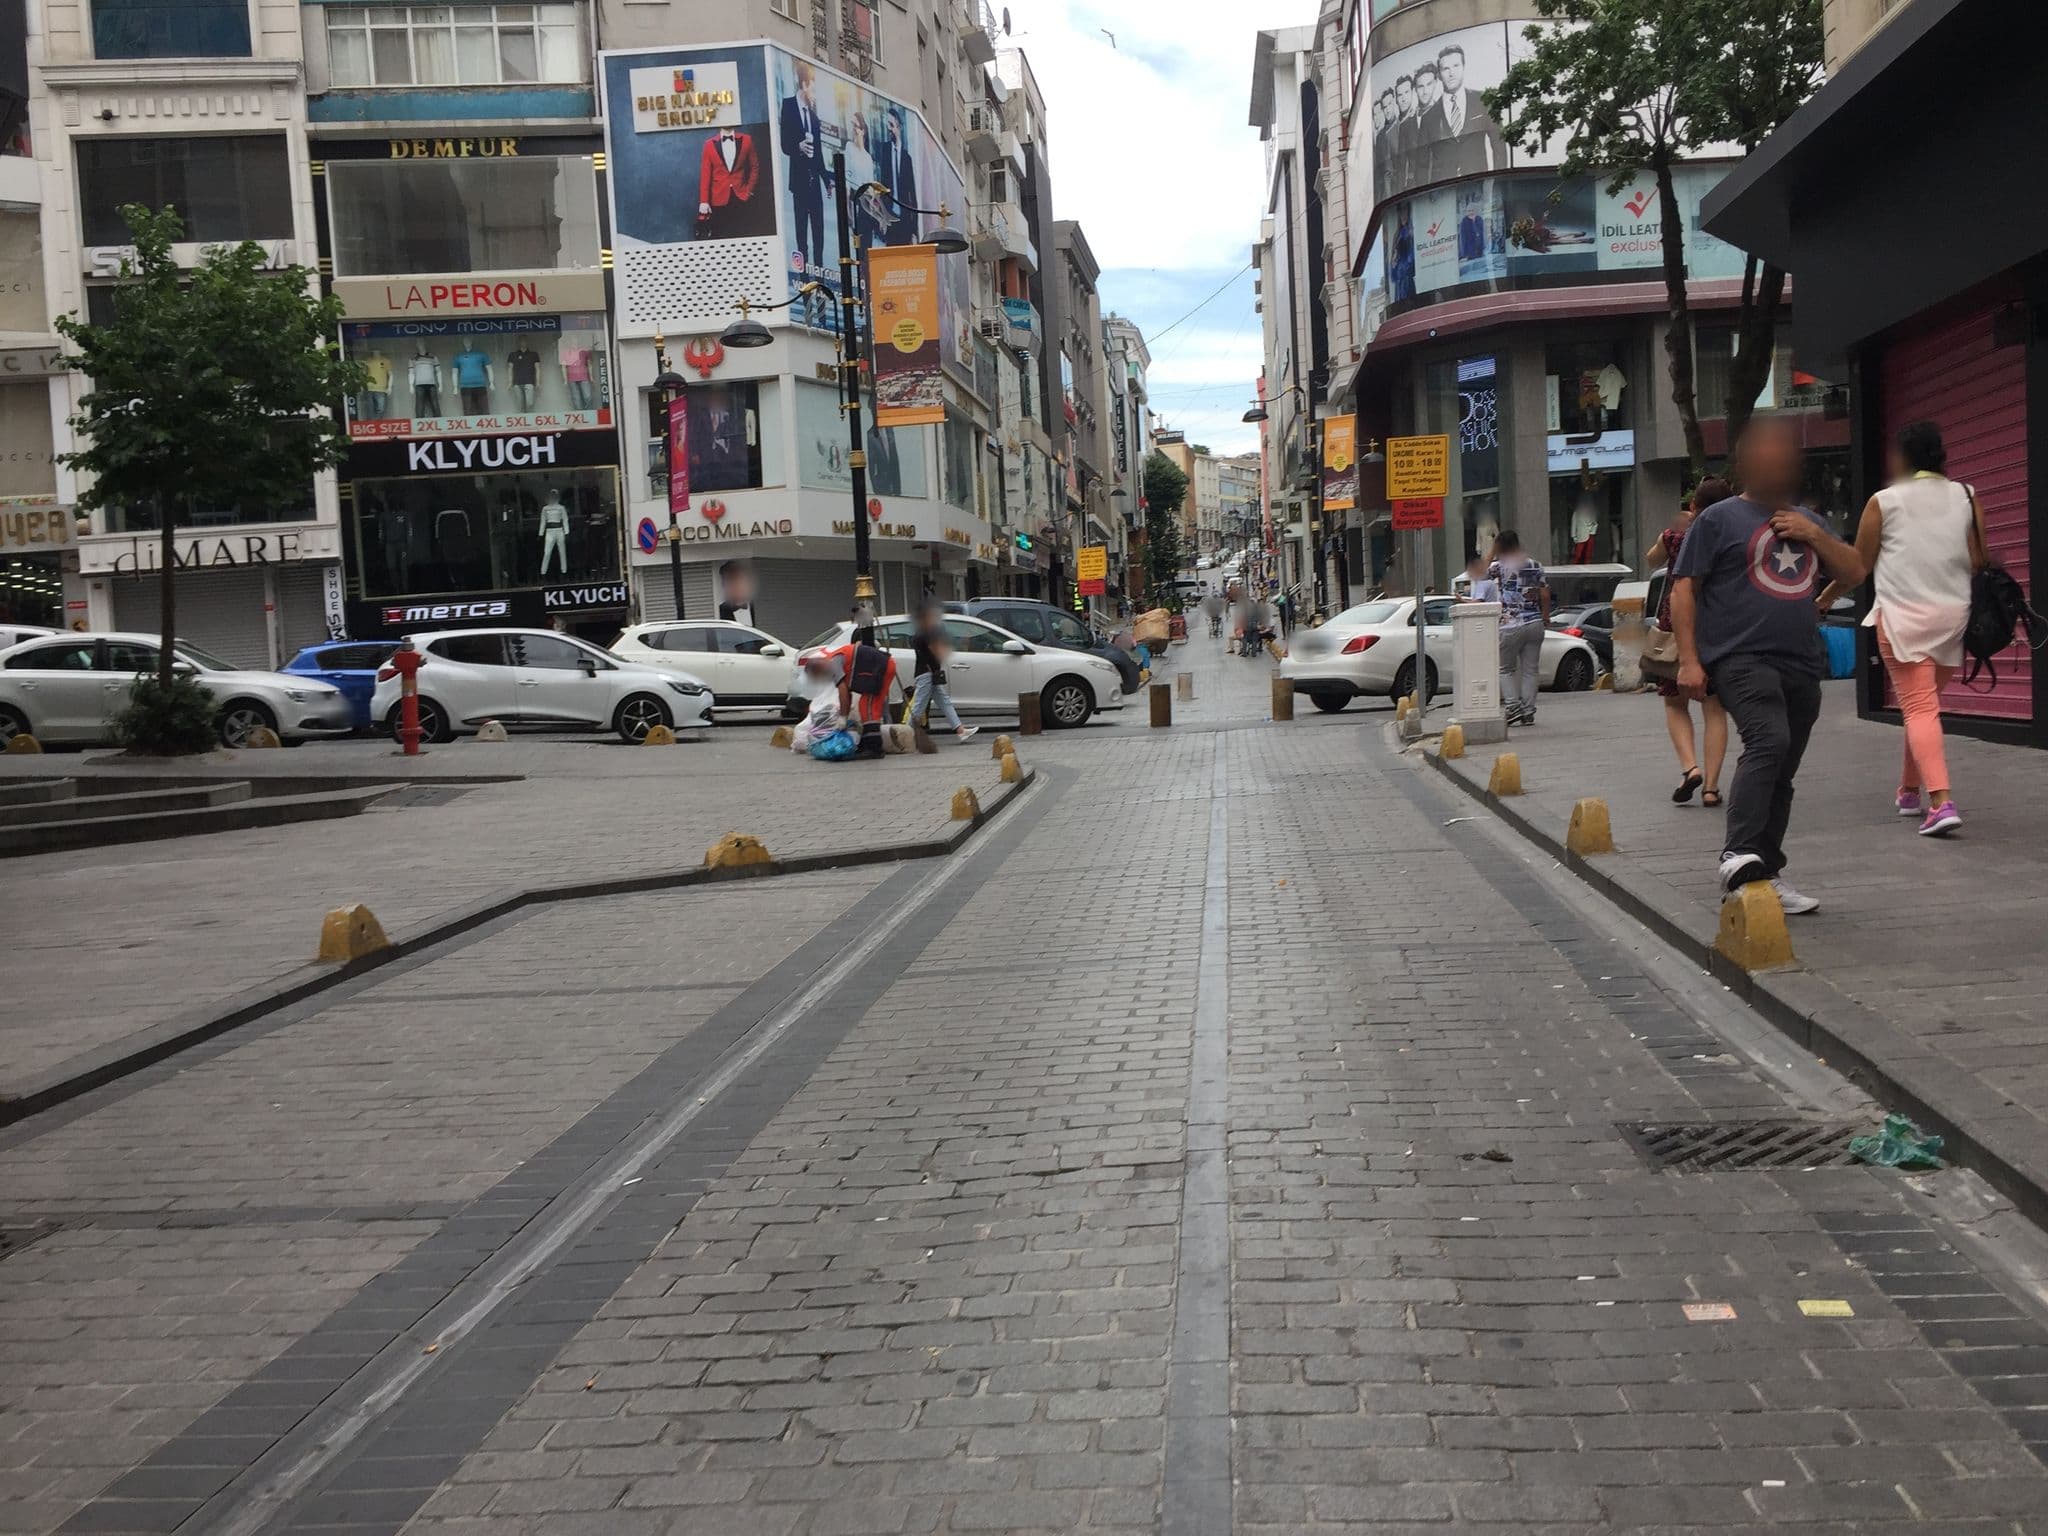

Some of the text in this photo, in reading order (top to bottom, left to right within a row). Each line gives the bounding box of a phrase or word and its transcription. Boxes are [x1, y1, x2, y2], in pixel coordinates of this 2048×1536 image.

[389, 137, 519, 159] DEMFUR
[1630, 223, 1660, 236] LEAT
[392, 318, 557, 335] TONY MONTANA
[599, 357, 609, 403] PERON
[352, 421, 409, 435] BIG SIZE
[417, 413, 590, 431] 2XL 3XL 4XL 5XL 6XL 7XL
[408, 436, 556, 472] KLYUCH
[715, 518, 793, 540] MILANO
[544, 586, 627, 607] KLYUCH
